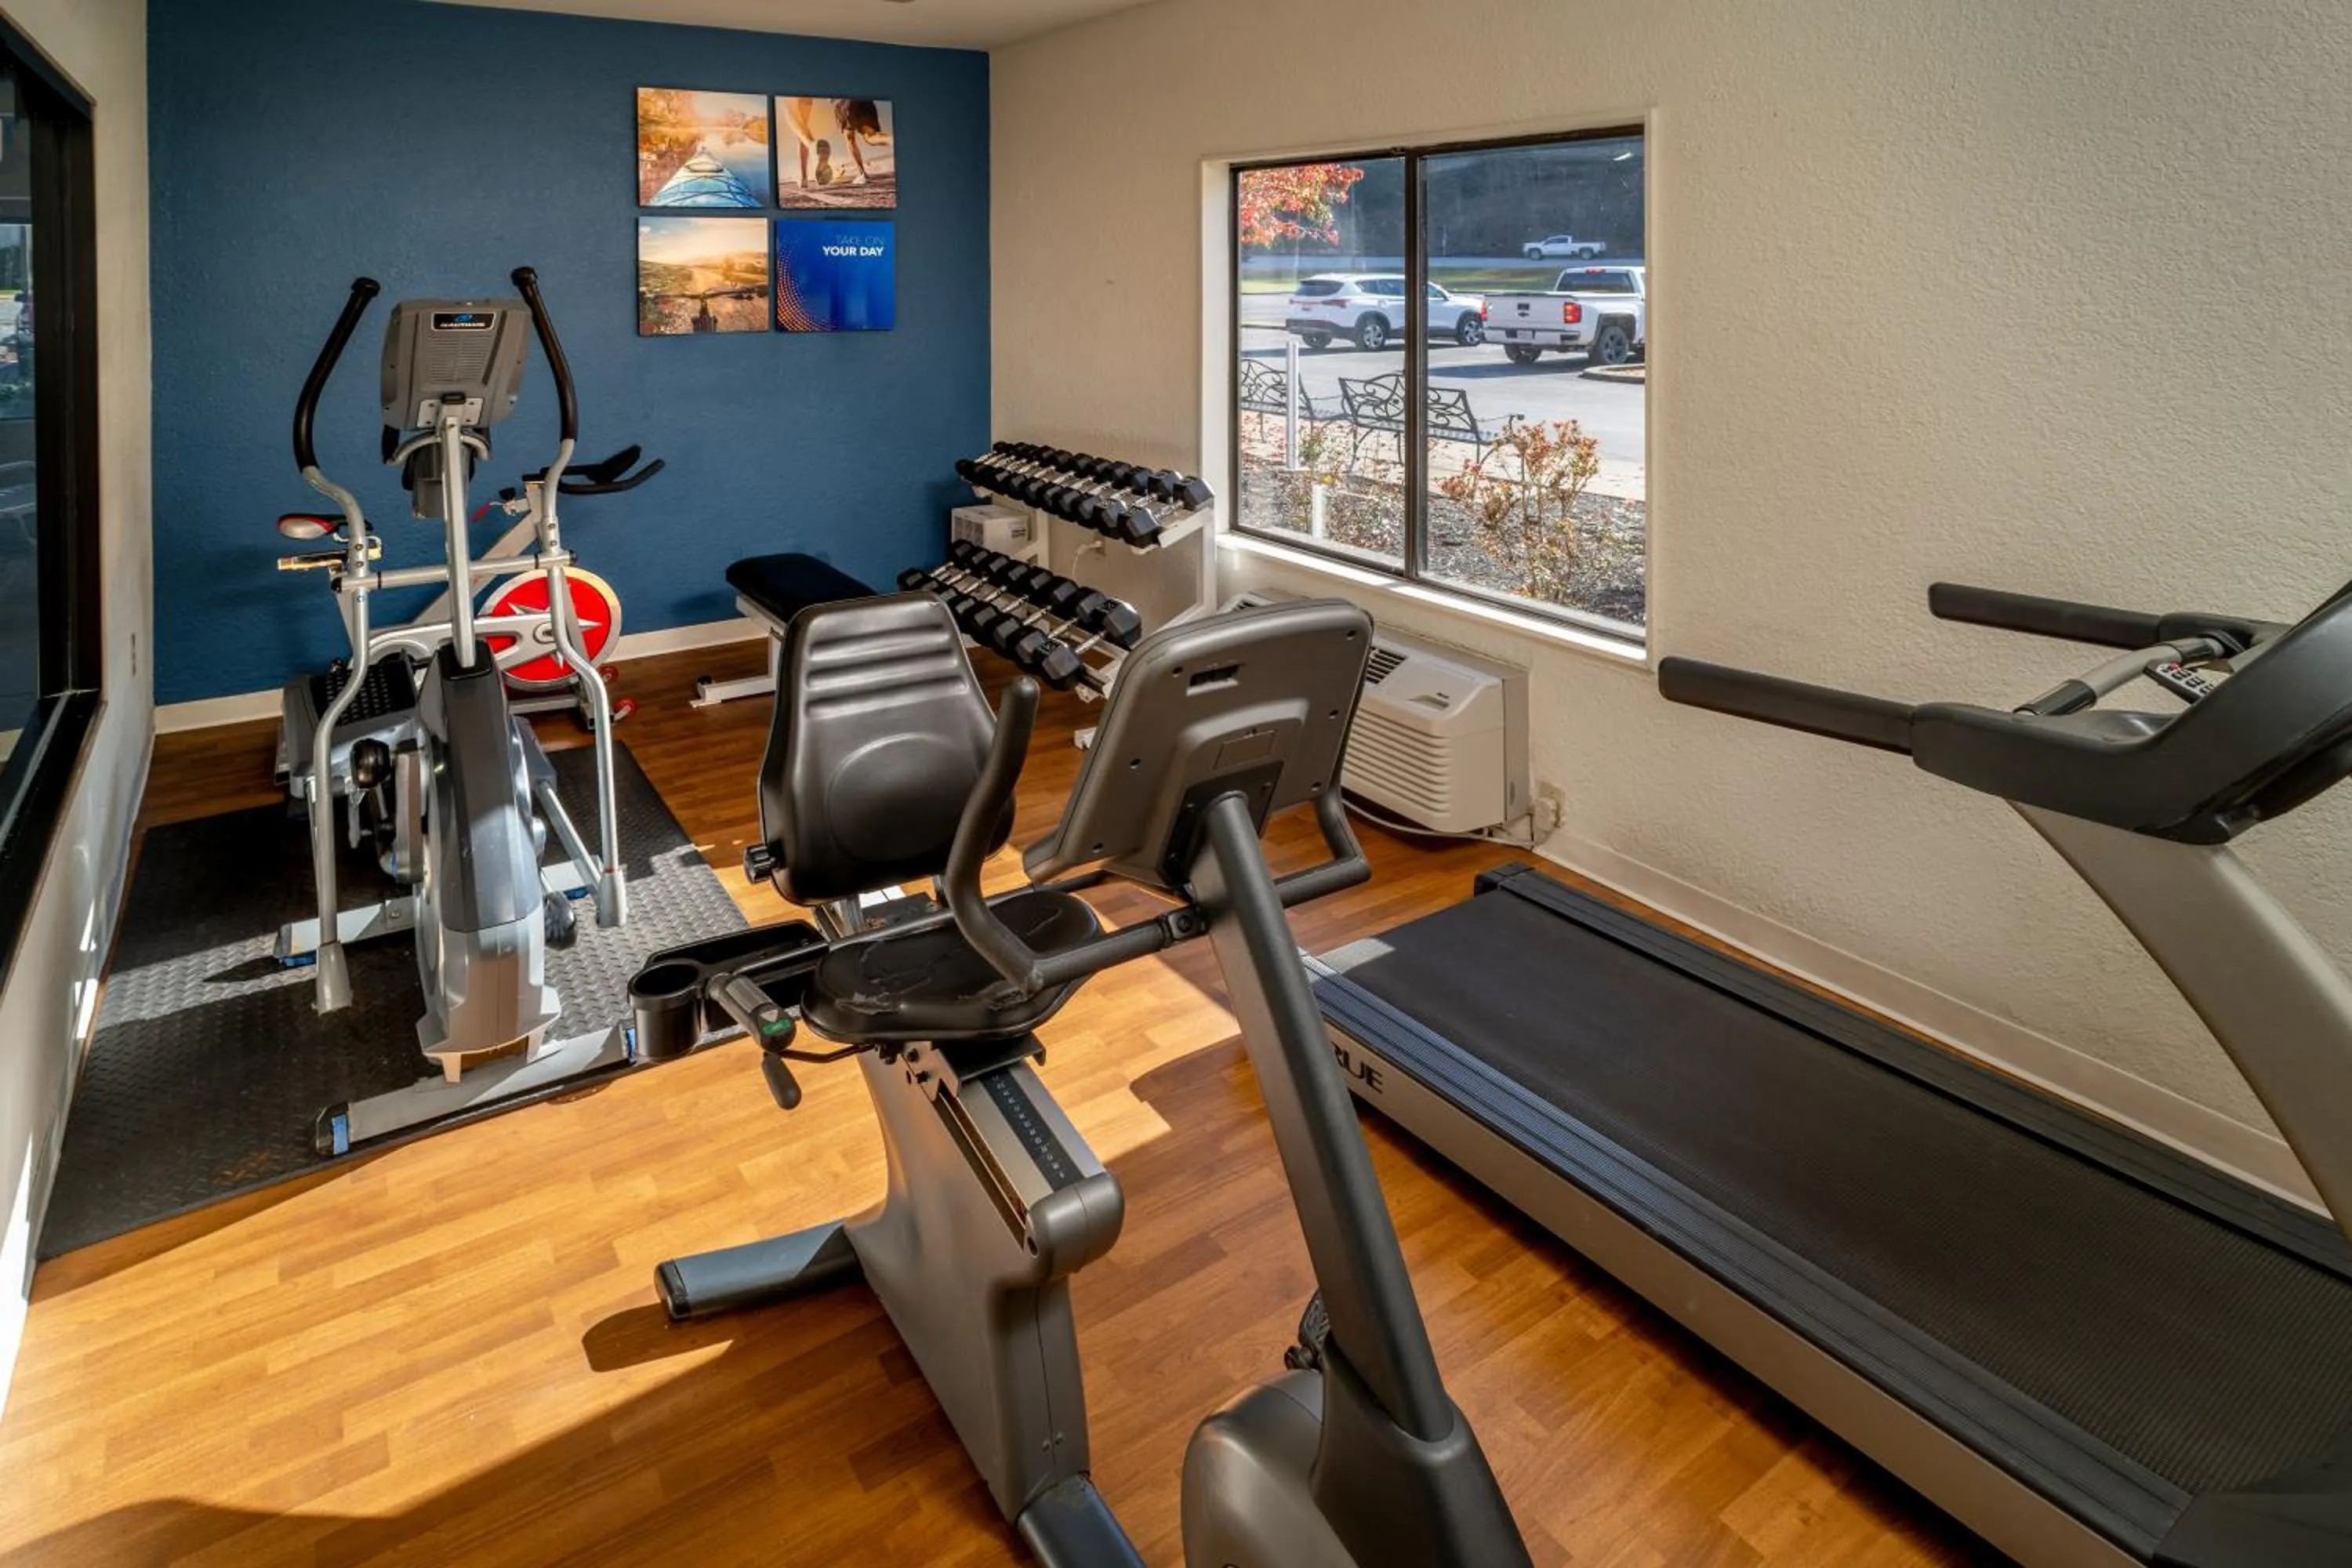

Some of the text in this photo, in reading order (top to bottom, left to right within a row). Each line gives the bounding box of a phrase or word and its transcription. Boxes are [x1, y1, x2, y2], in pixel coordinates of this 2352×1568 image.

[836, 235, 884, 245] TAKE ON
[822, 245, 884, 256] YOUR DAY
